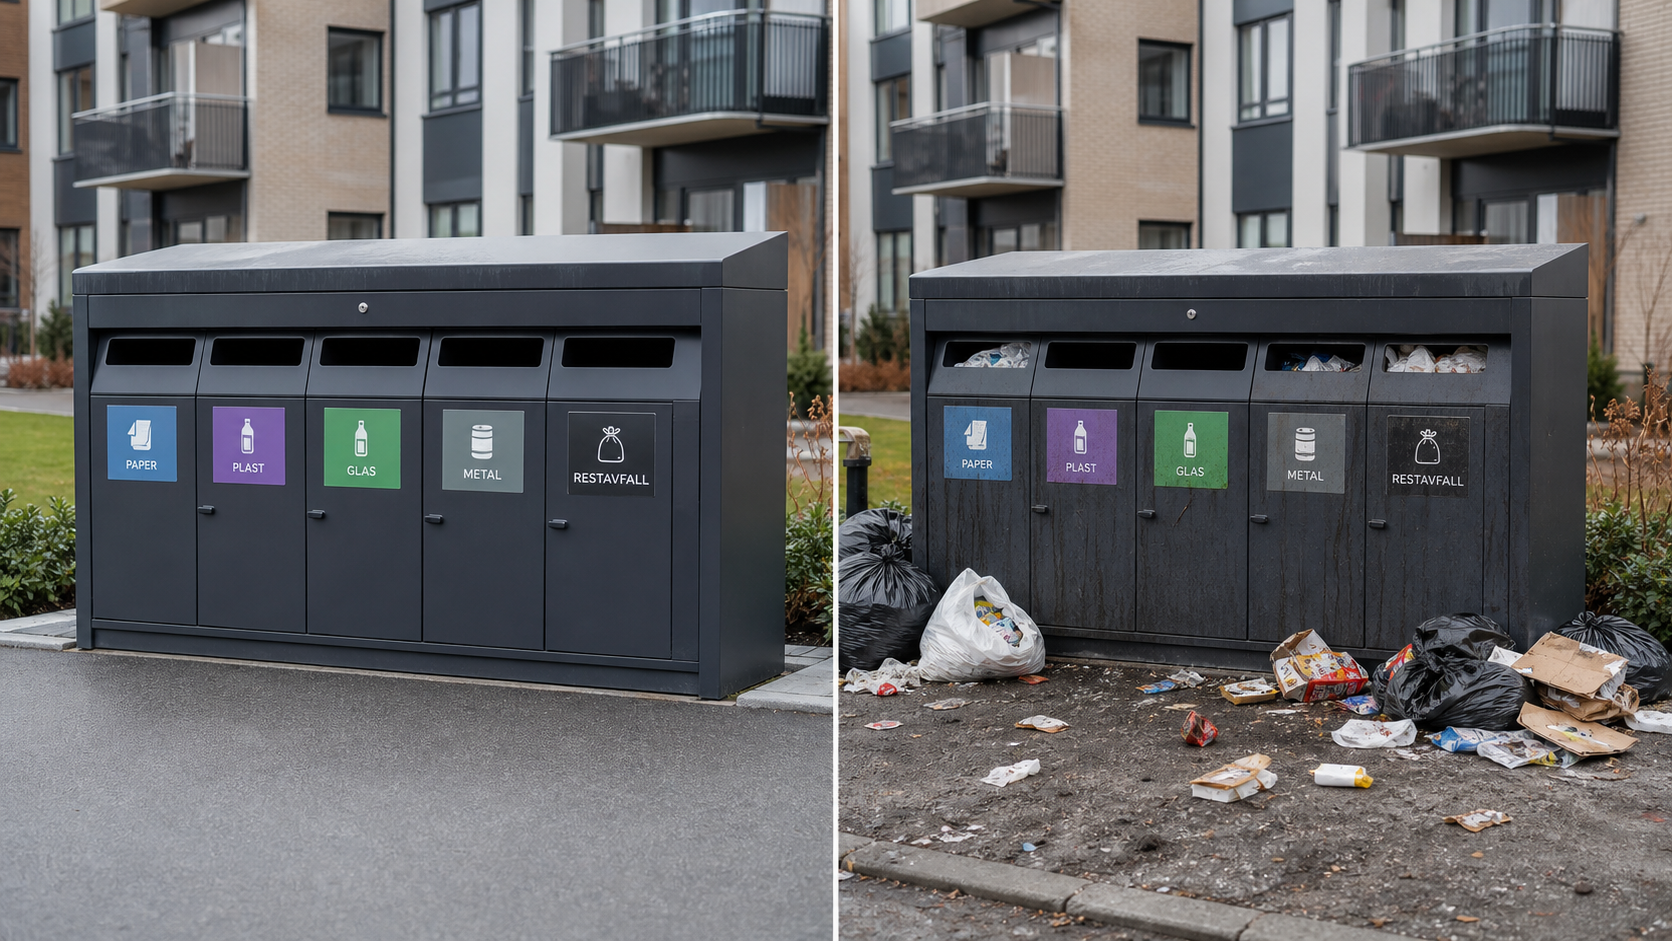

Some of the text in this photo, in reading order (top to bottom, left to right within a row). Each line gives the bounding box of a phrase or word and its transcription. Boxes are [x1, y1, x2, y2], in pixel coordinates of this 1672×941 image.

[126, 459, 157, 470] PAPER
[232, 462, 265, 473] PLAST
[961, 459, 993, 469] PAPER
[1065, 462, 1097, 473] PLAST
[346, 465, 376, 477] GLAS
[463, 468, 502, 481] METAL
[1176, 465, 1205, 477] GLAS
[1287, 469, 1324, 482] METAL
[573, 472, 650, 486] RESTAVFALL
[1392, 473, 1464, 487] RESTAVFALL
